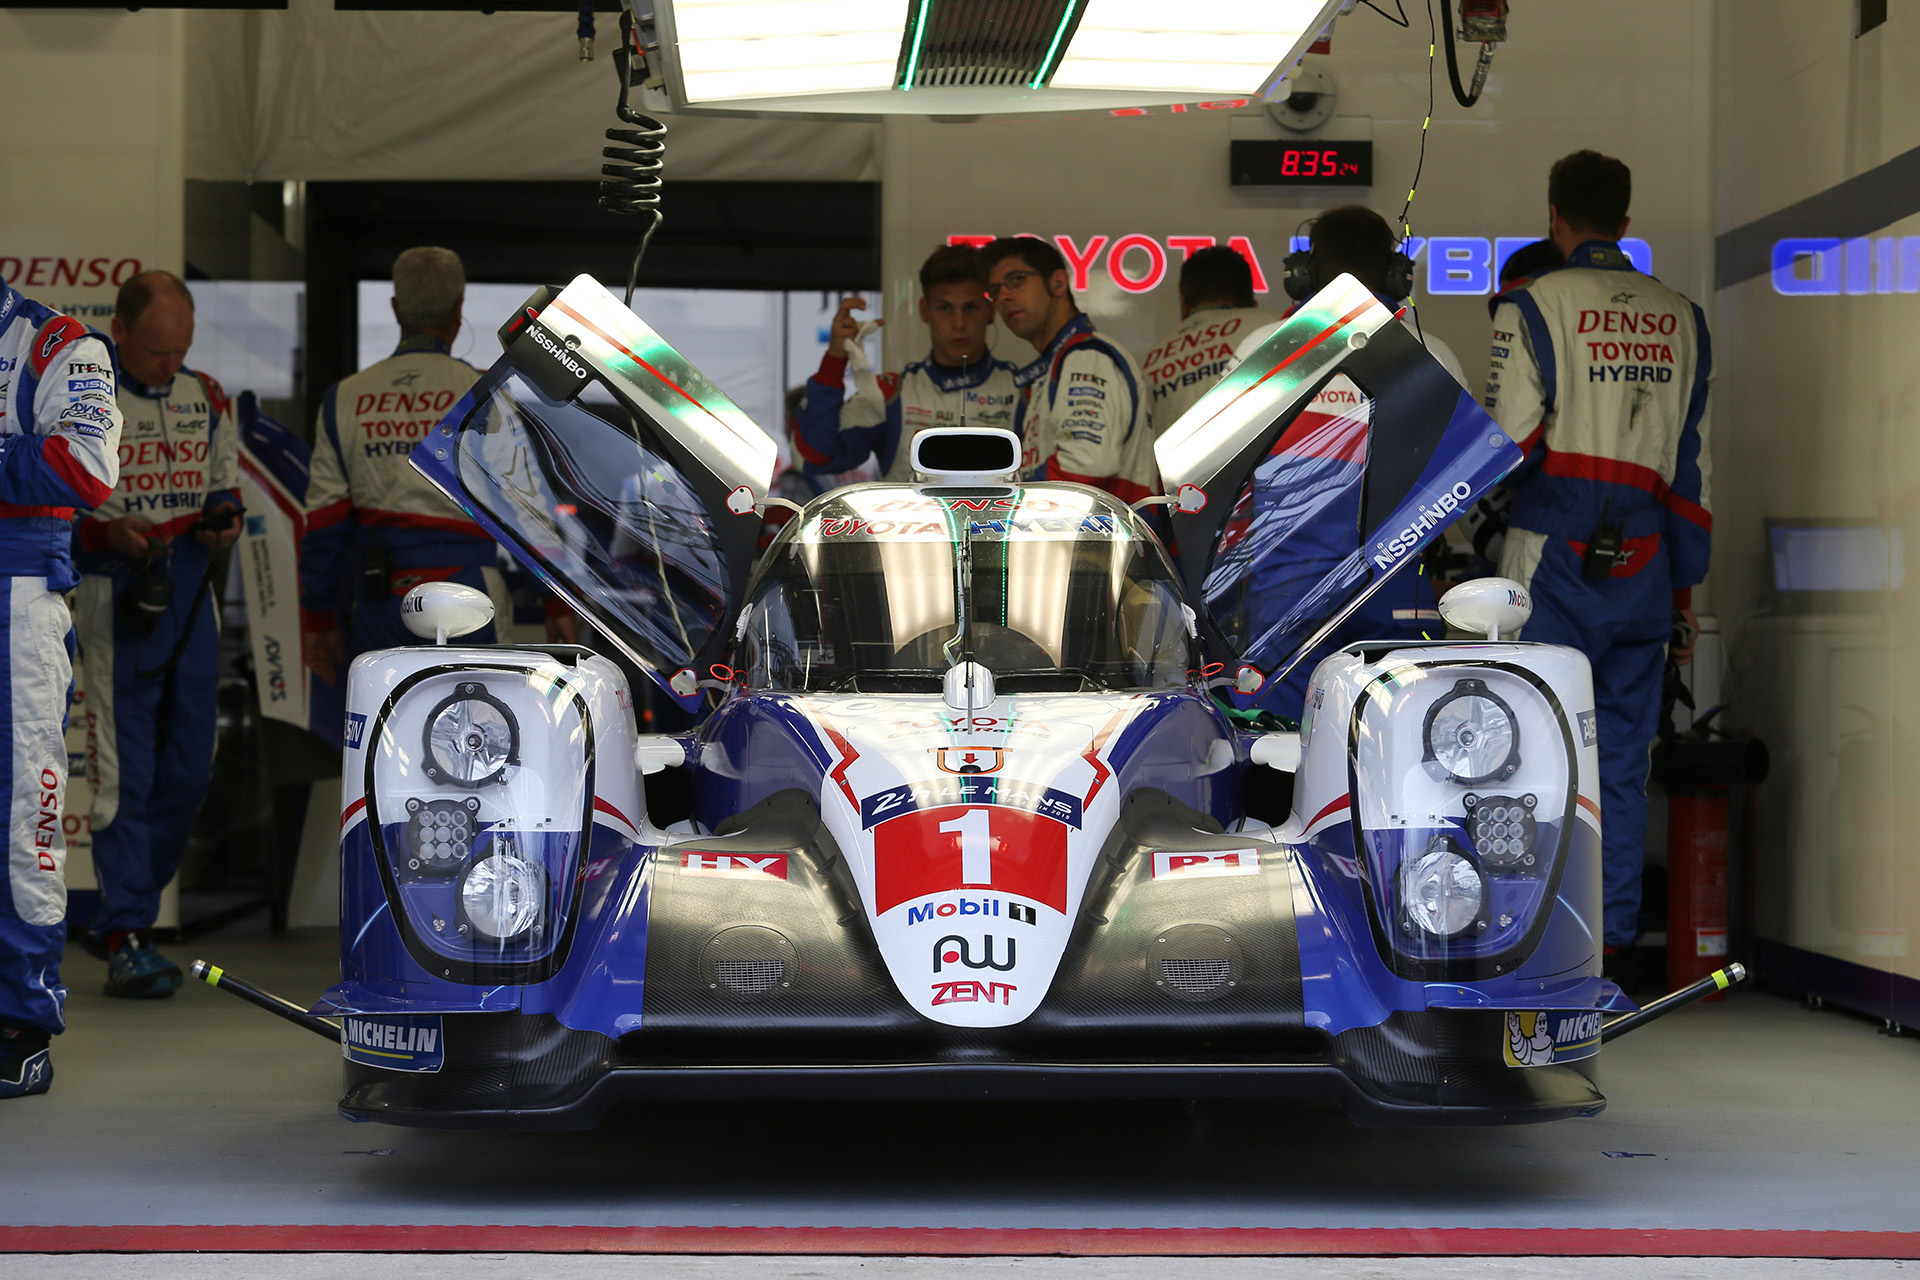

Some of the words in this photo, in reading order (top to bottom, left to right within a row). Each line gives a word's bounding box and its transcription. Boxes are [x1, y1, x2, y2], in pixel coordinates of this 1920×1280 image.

[0, 256, 142, 287] DENSO
[1577, 309, 1677, 336] DENSO
[1143, 318, 1242, 370] DENSO
[1587, 341, 1675, 364] TOYOTA
[1149, 342, 1234, 384] TOYOTA
[1589, 365, 1672, 383] HYBRID
[72, 381, 111, 393] AISIN
[1311, 390, 1357, 404] YOTA
[355, 390, 455, 416] DENSO
[119, 440, 209, 467] DENSO
[872, 499, 1060, 513] DENSO
[815, 518, 946, 538] TOYOTA
[984, 786, 1072, 814] MANS
[36, 768, 58, 871] DENSO
[938, 809, 992, 885] 1
[1169, 853, 1240, 874] P1
[908, 898, 999, 926] Mobil
[931, 980, 1017, 1006] ZENT
[348, 1017, 438, 1053] MICHELIN
[1556, 1012, 1600, 1043] MICHE
